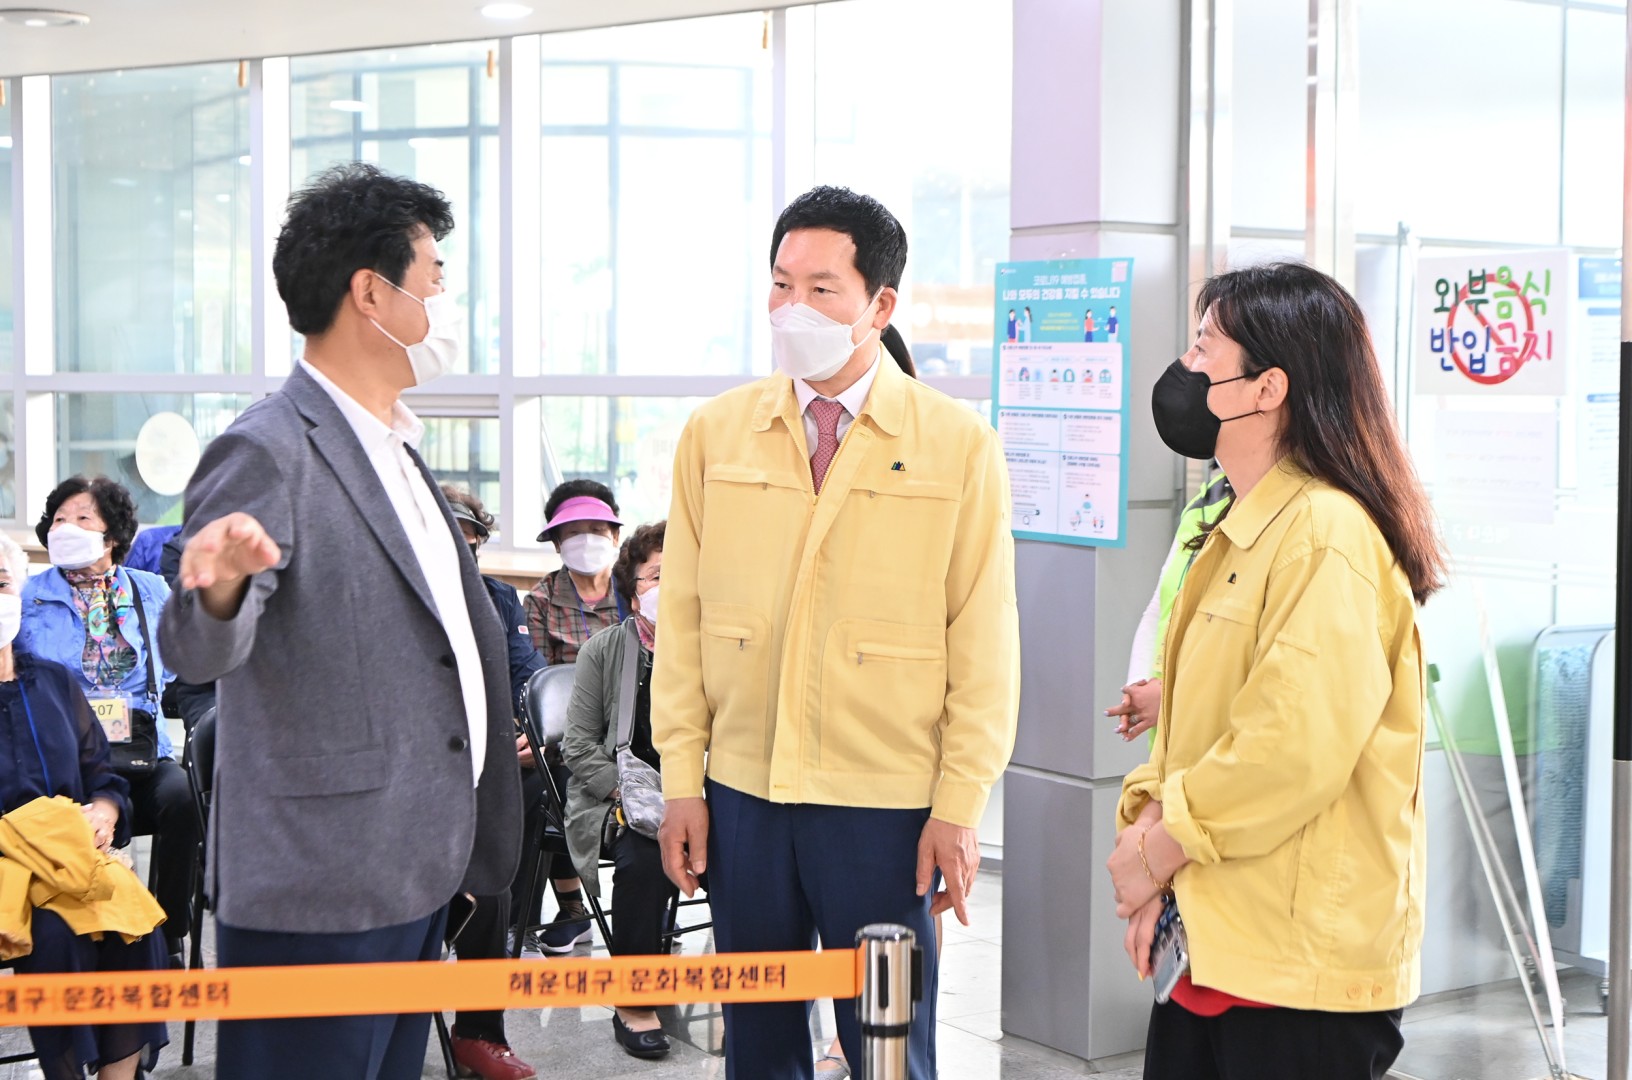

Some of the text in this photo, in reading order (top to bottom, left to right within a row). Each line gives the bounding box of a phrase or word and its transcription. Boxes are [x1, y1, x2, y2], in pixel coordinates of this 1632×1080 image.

[1019, 289, 1040, 300] 모두의
[1042, 288, 1063, 300] 건강을
[1080, 287, 1089, 300] 수
[1090, 286, 1121, 299] 있습니다
[510, 964, 786, 996] 해운대구 문화복합센터
[64, 981, 230, 1012] 문화복합센터
